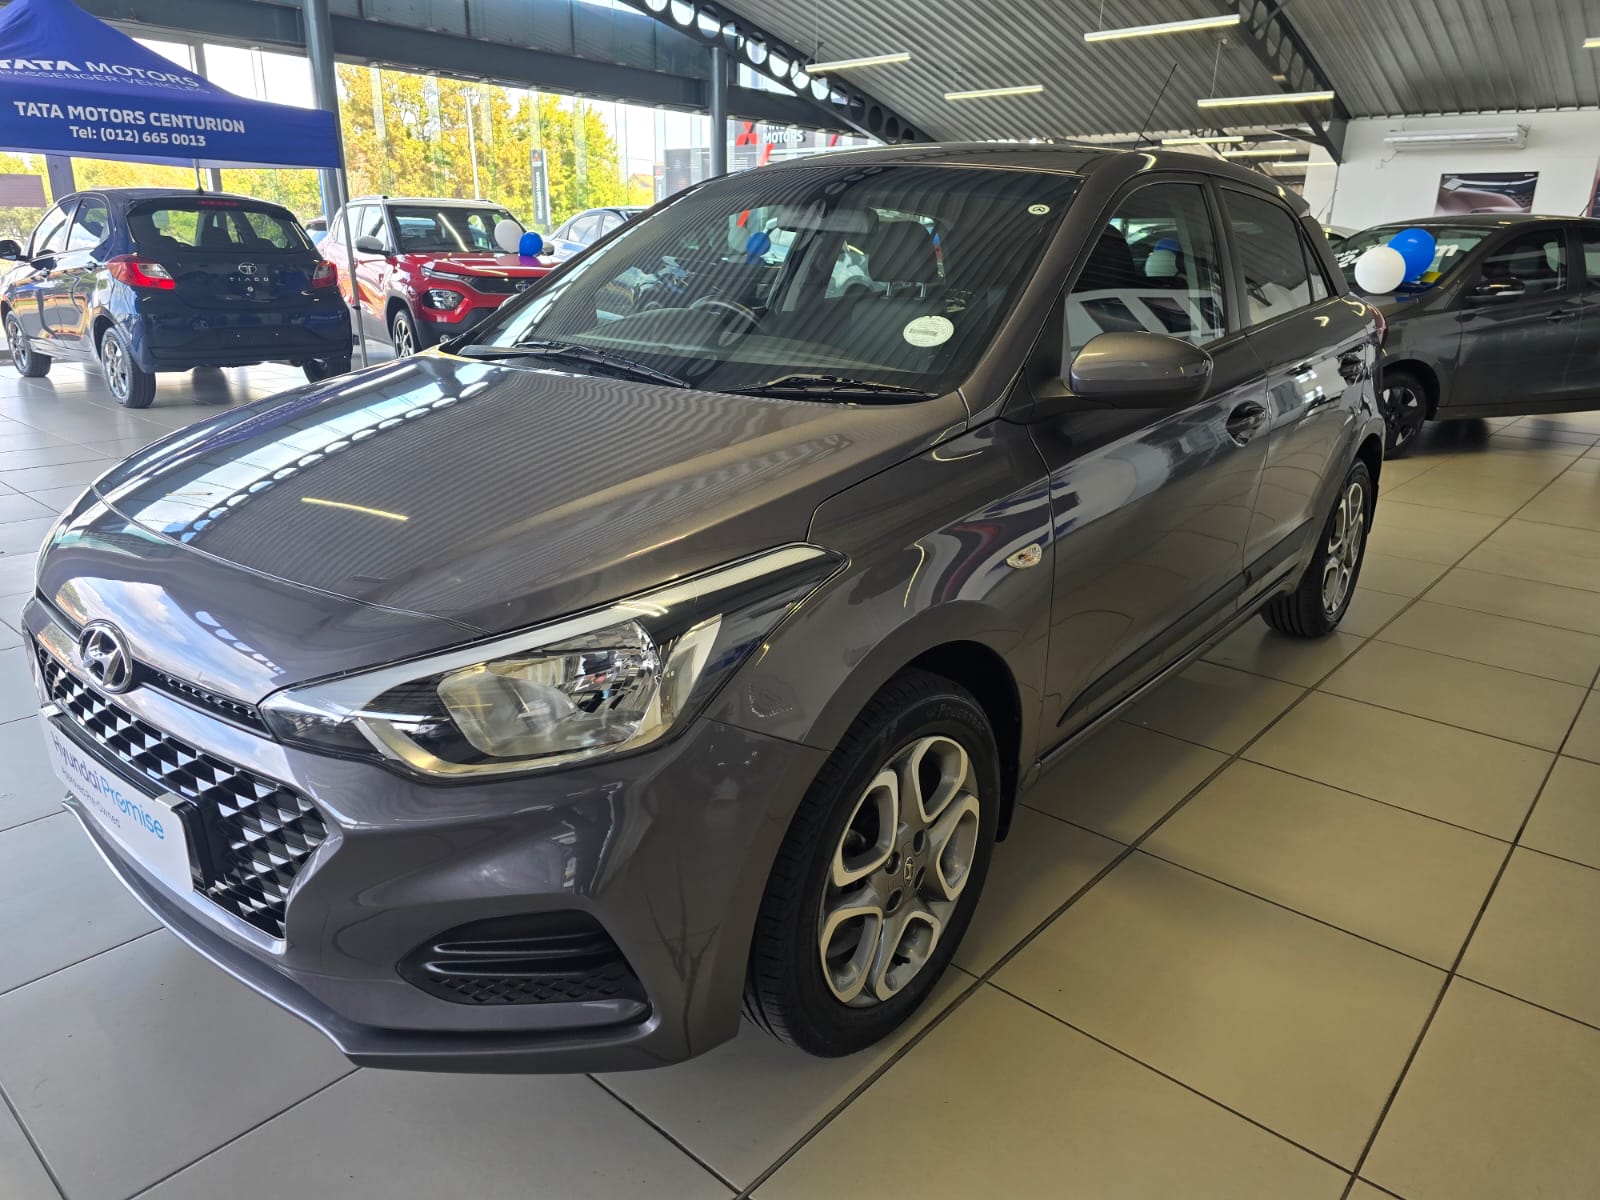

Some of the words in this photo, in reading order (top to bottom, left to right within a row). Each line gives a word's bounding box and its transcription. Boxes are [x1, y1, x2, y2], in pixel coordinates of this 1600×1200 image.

[0, 58, 81, 71] TATA
[85, 61, 200, 88] MOTORS
[13, 101, 65, 119] TATA
[67, 105, 146, 125] MOTORS
[149, 112, 246, 133] CENTURION
[69, 126, 98, 139] Tel:
[100, 127, 139, 143] (012)
[142, 132, 169, 144] 665
[171, 133, 207, 147] 0013
[762, 130, 804, 143] MOTORS
[51, 730, 102, 793] Hyundai
[100, 775, 165, 840] Promise
